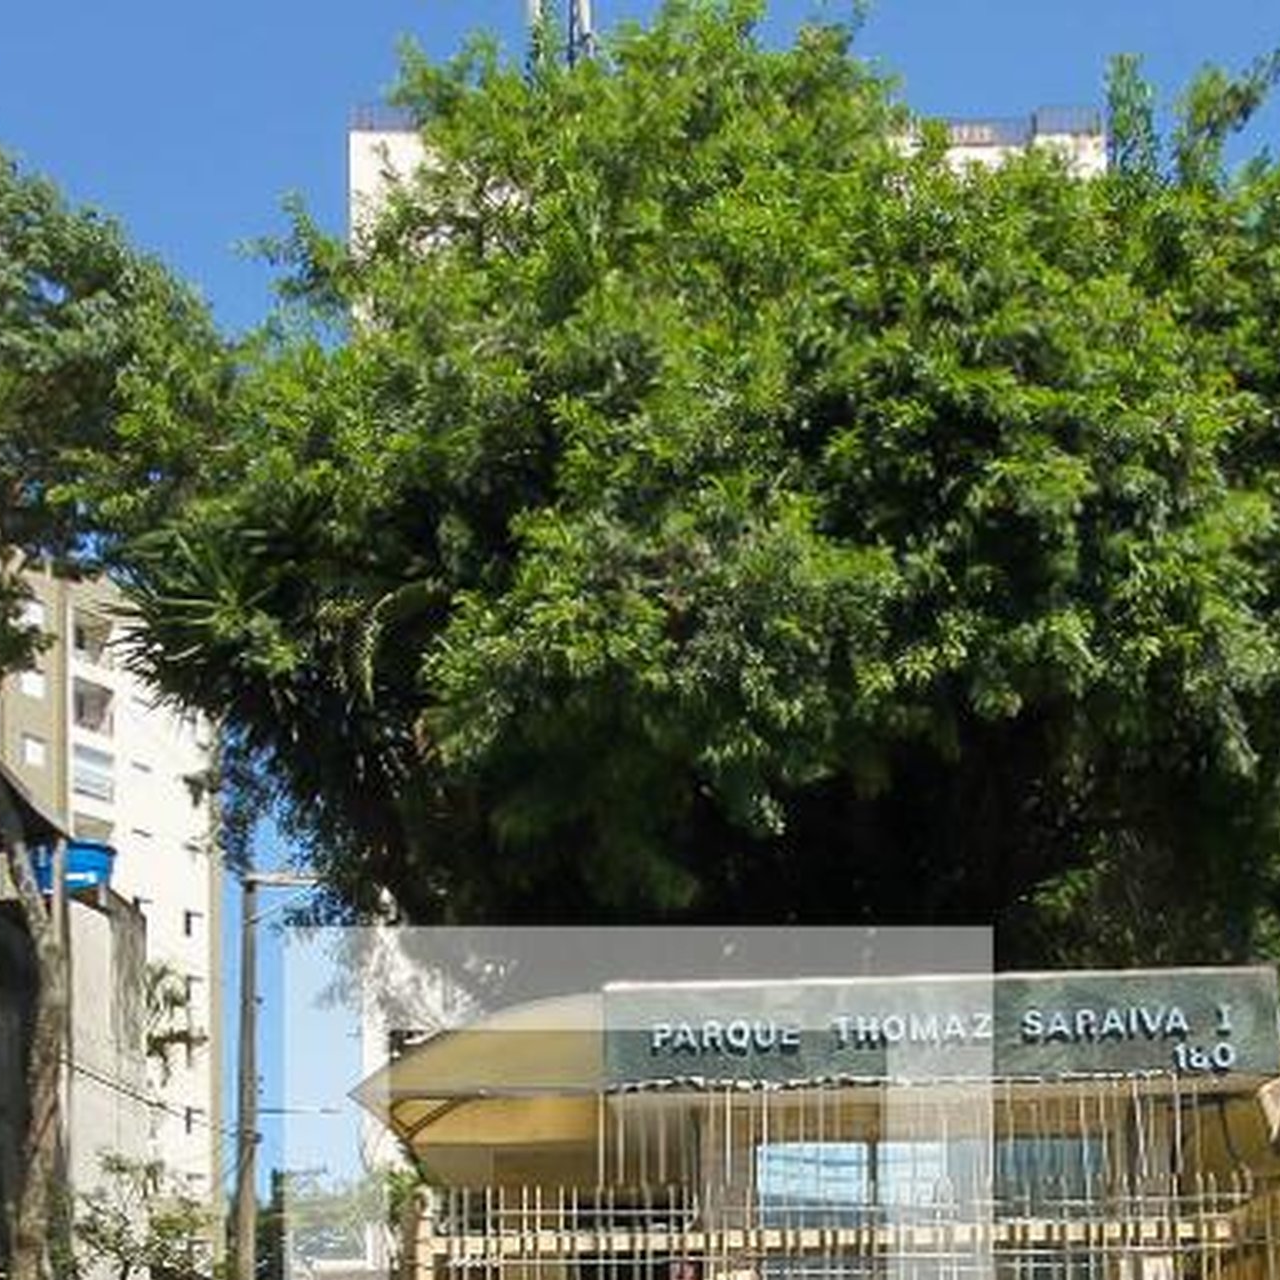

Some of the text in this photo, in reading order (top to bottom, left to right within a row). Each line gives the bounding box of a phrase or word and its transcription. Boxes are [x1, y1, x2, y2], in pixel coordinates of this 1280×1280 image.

[651, 1019, 800, 1049] PARQUE
[832, 1012, 994, 1042] THOMAZ
[1022, 1005, 1189, 1035] SARAIVA
